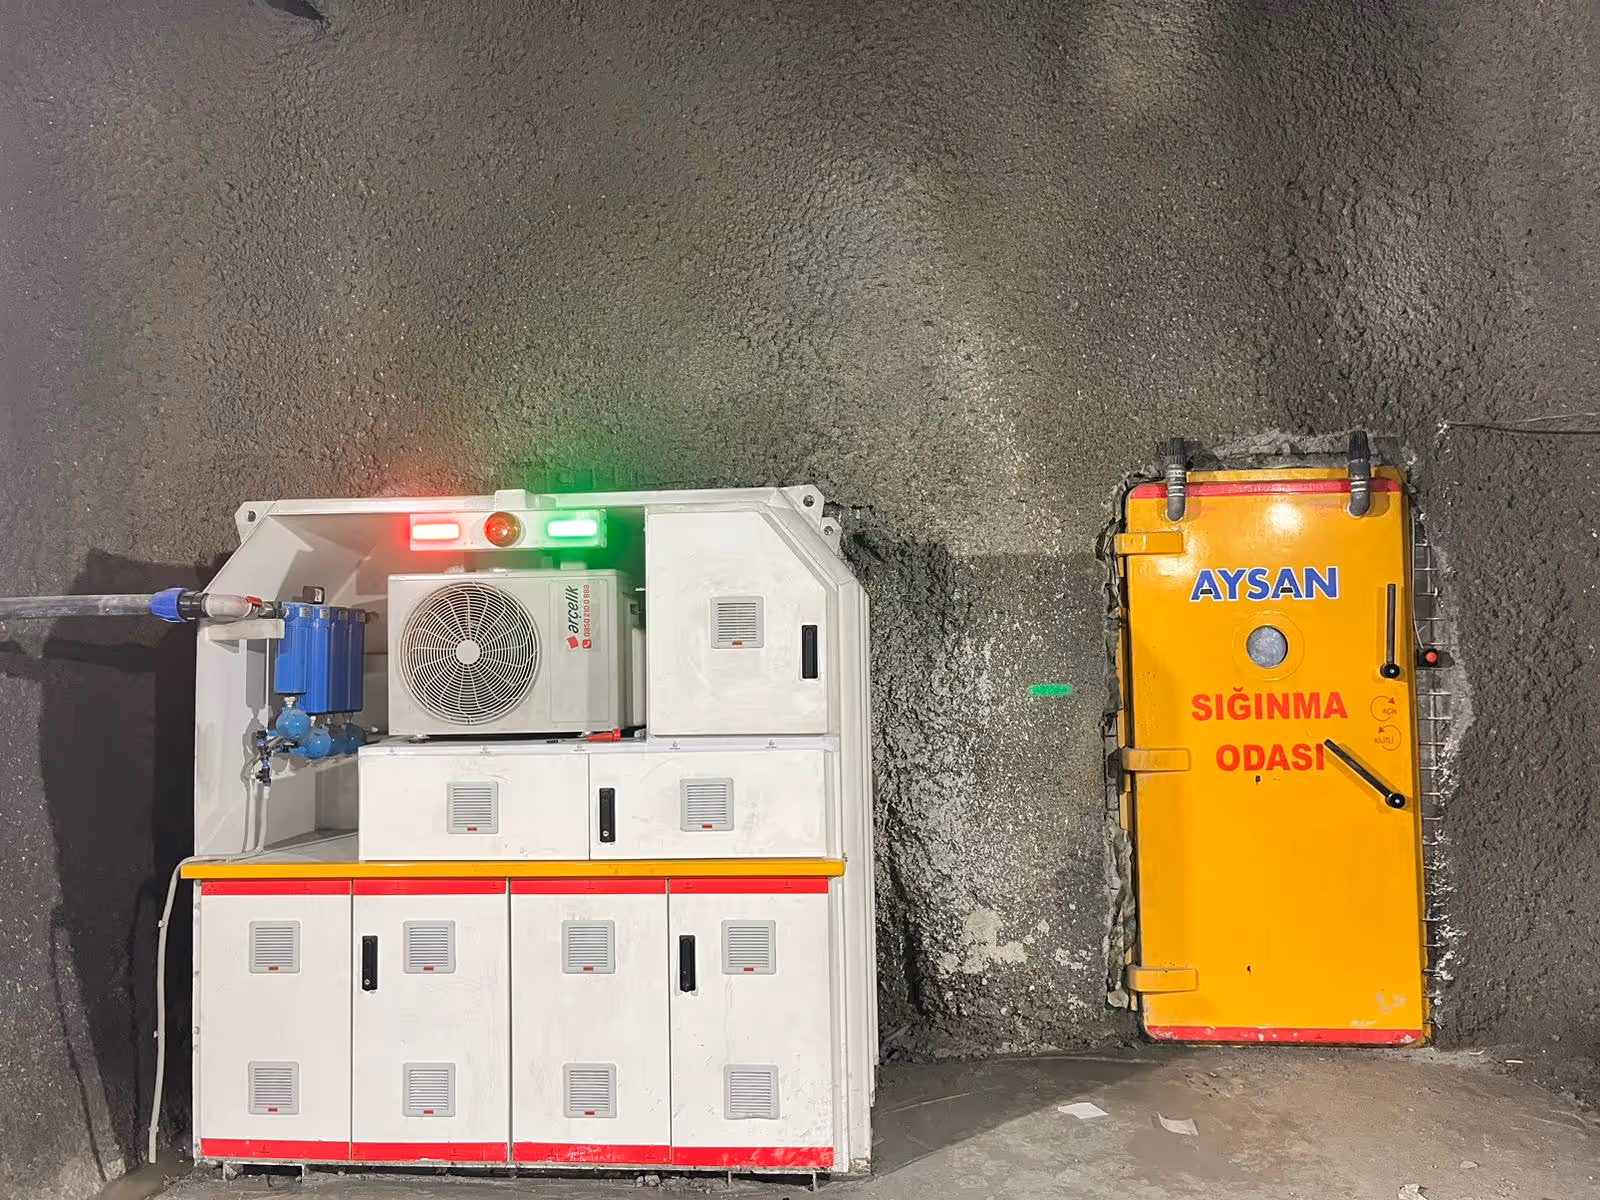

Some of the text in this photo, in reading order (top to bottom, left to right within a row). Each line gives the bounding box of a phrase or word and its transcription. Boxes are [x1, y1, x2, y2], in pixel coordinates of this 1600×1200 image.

[1190, 566, 1338, 601] AYSAN
[565, 585, 581, 633] arçelik
[1191, 687, 1348, 721] SIĞINMA
[1216, 743, 1325, 772] ODASI
